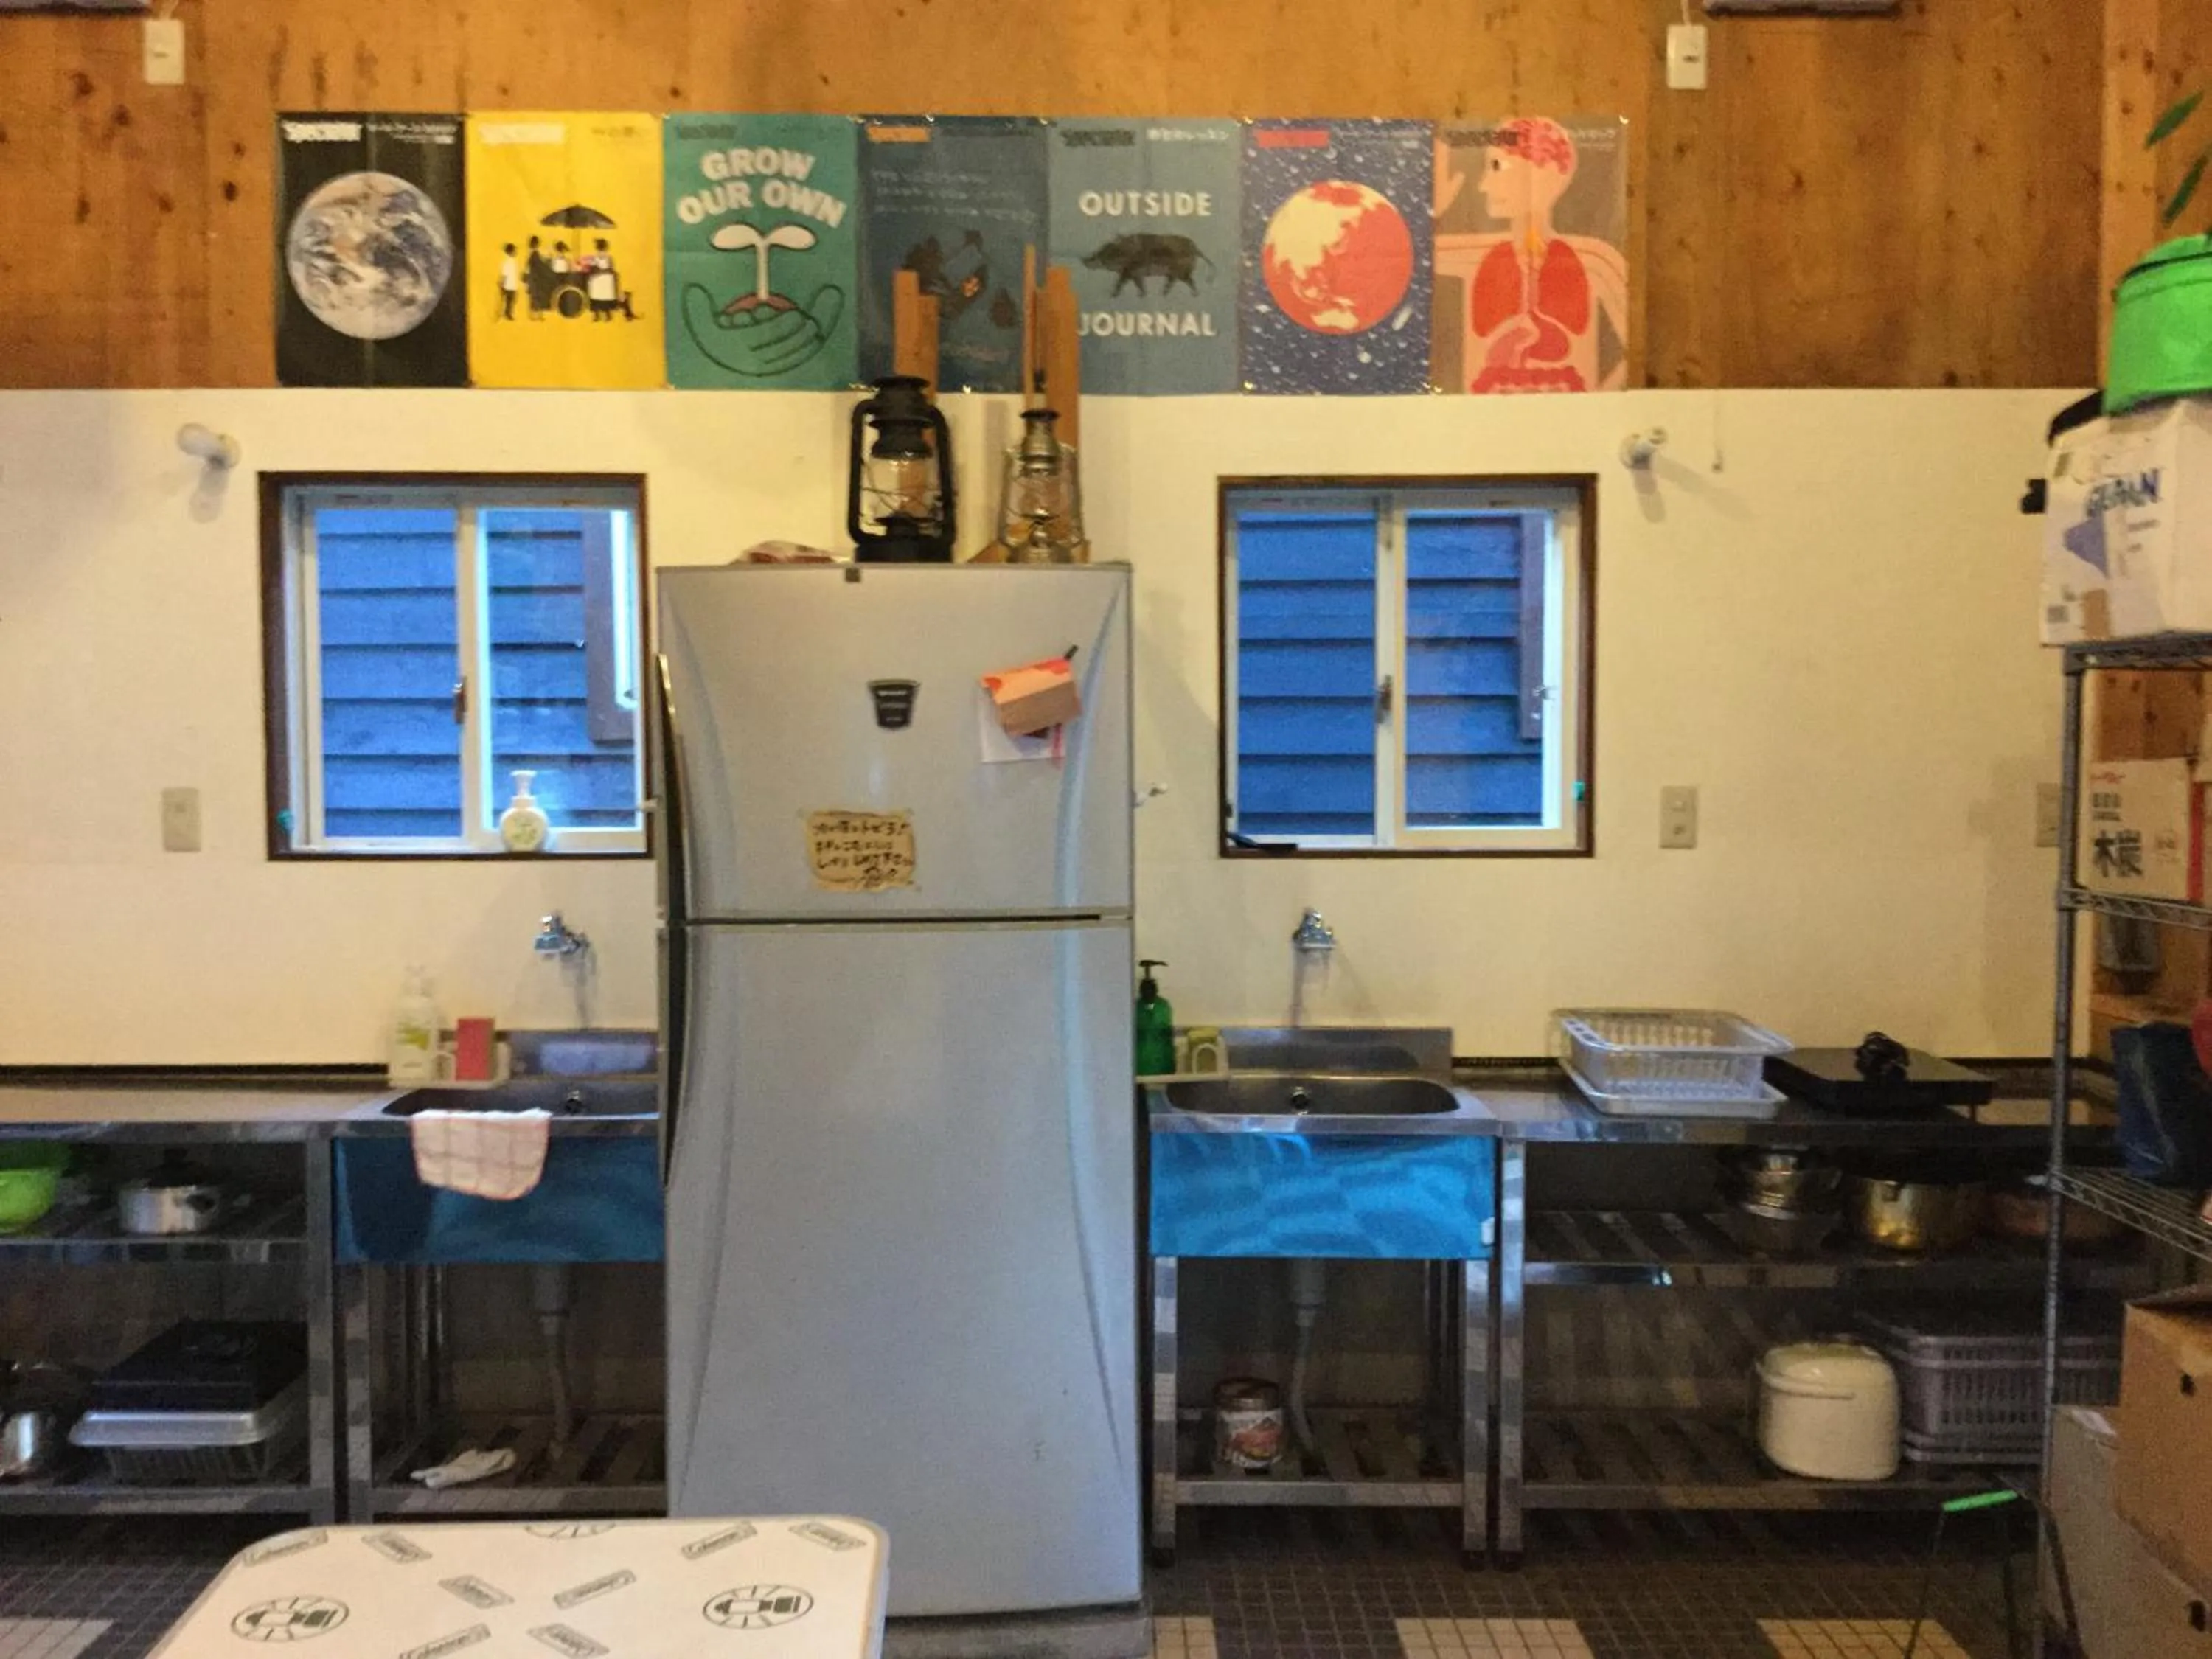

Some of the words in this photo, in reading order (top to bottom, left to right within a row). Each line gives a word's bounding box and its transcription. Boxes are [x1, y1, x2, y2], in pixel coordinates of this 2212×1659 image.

[702, 147, 815, 181] GROW
[677, 181, 754, 225] OUR
[762, 178, 847, 229] OWN
[1079, 190, 1212, 217] OUTSIDE
[1079, 310, 1217, 338] JOURNAL
